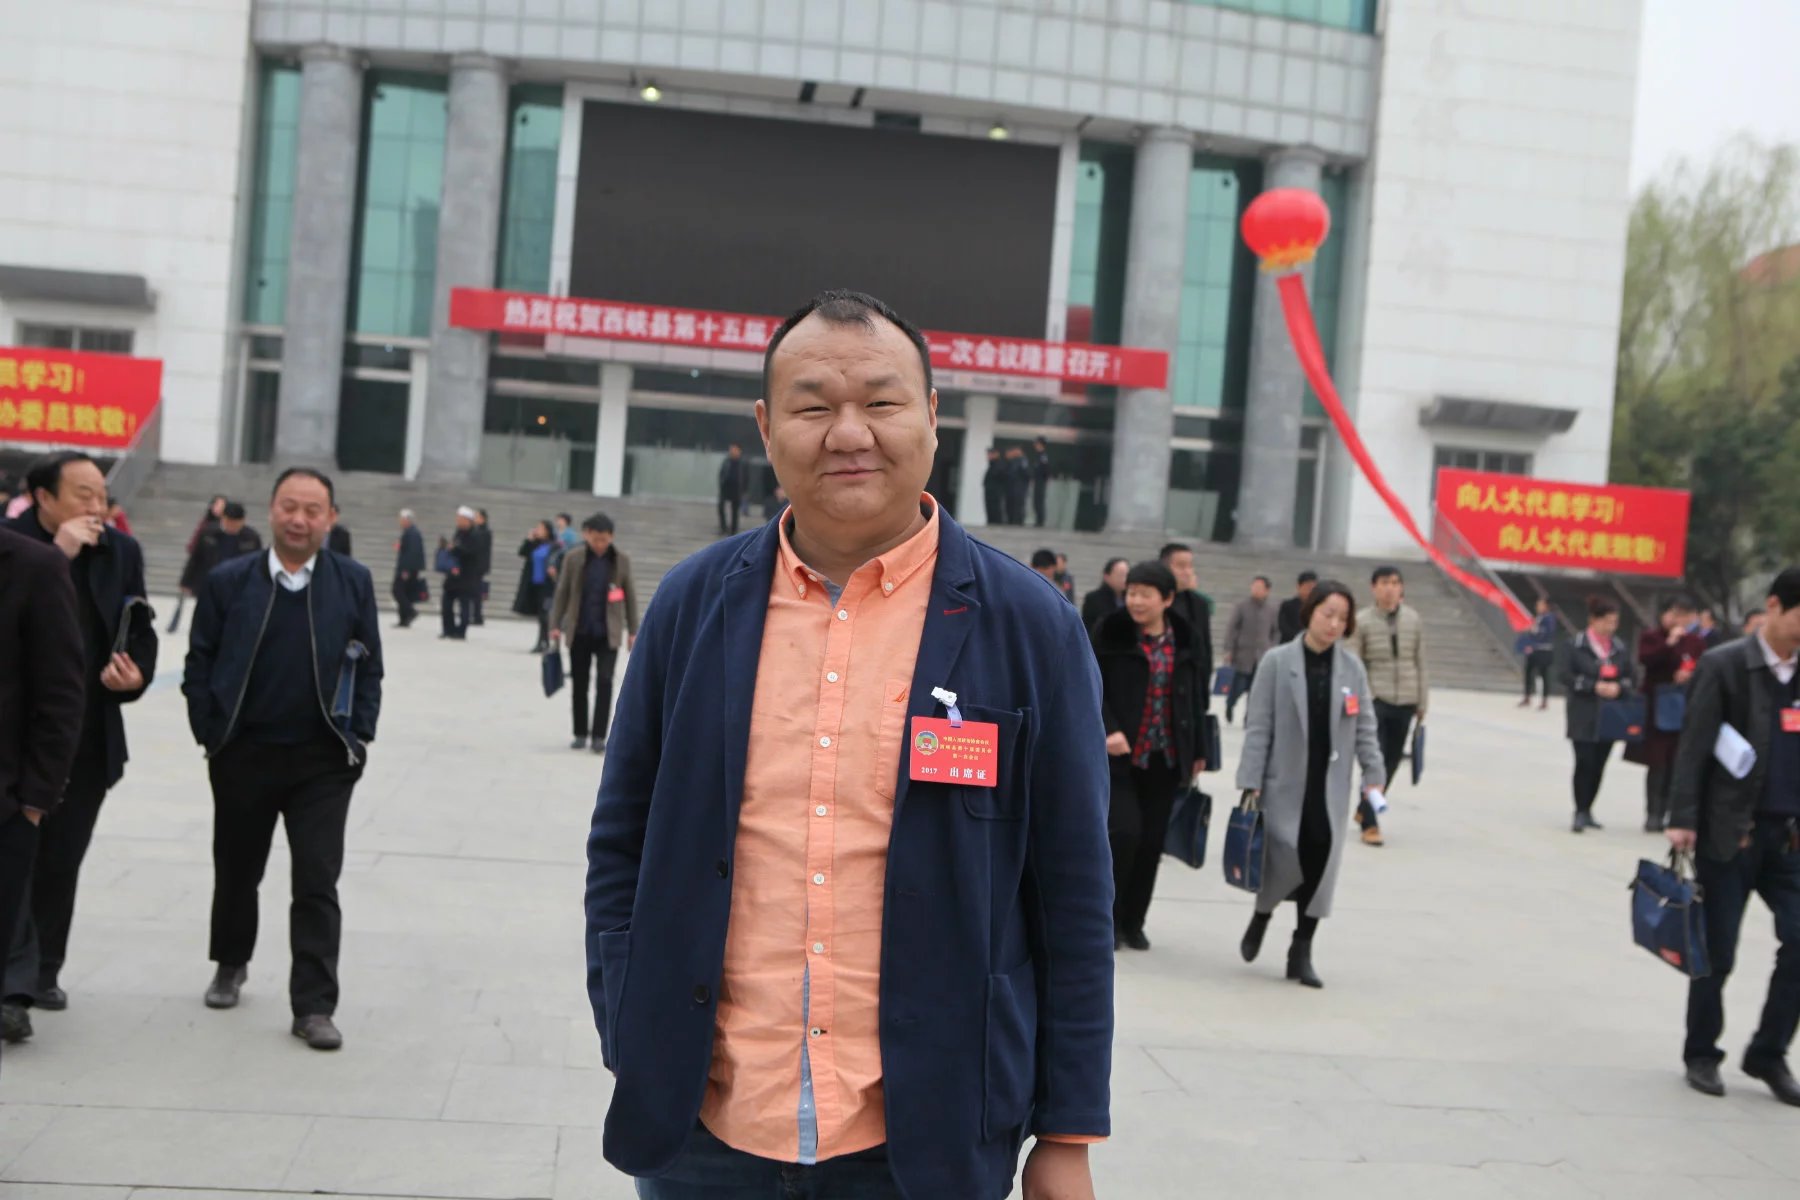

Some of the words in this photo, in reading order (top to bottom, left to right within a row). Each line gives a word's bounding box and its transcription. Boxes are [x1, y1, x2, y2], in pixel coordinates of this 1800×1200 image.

[923, 336, 1121, 381] 一次会议隆重召开！
[1456, 481, 1624, 524] 向人大代表学习！
[949, 767, 987, 780] 出席证
